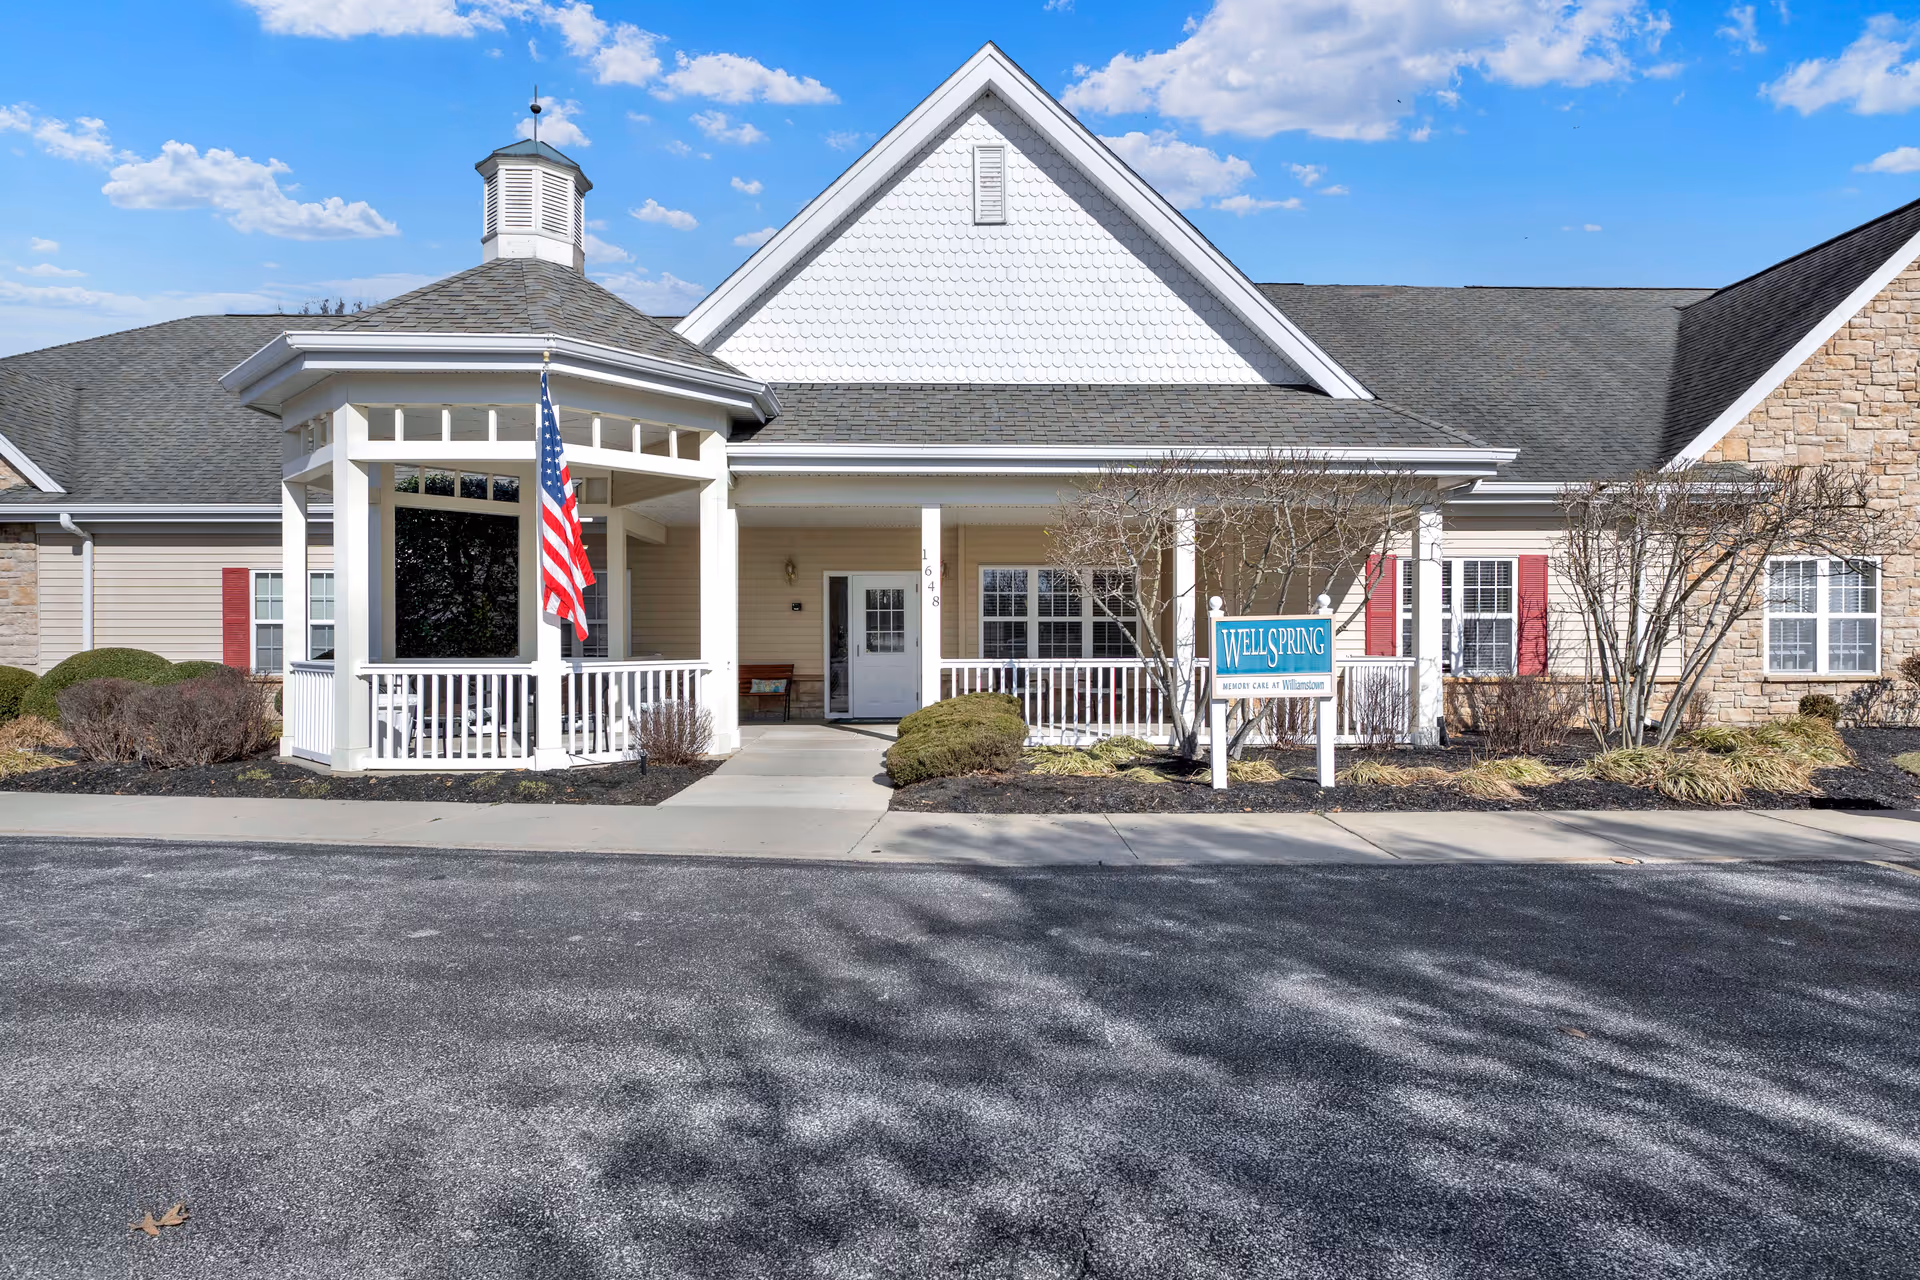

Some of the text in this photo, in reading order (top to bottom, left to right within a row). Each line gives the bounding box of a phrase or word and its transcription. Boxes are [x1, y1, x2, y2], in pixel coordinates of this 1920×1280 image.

[922, 548, 940, 607] 1648
[1221, 627, 1325, 669] WELLSPRING
[1222, 682, 1250, 690] MEMORY
[1272, 681, 1280, 689] AT
[1282, 679, 1324, 690] Williamstown
